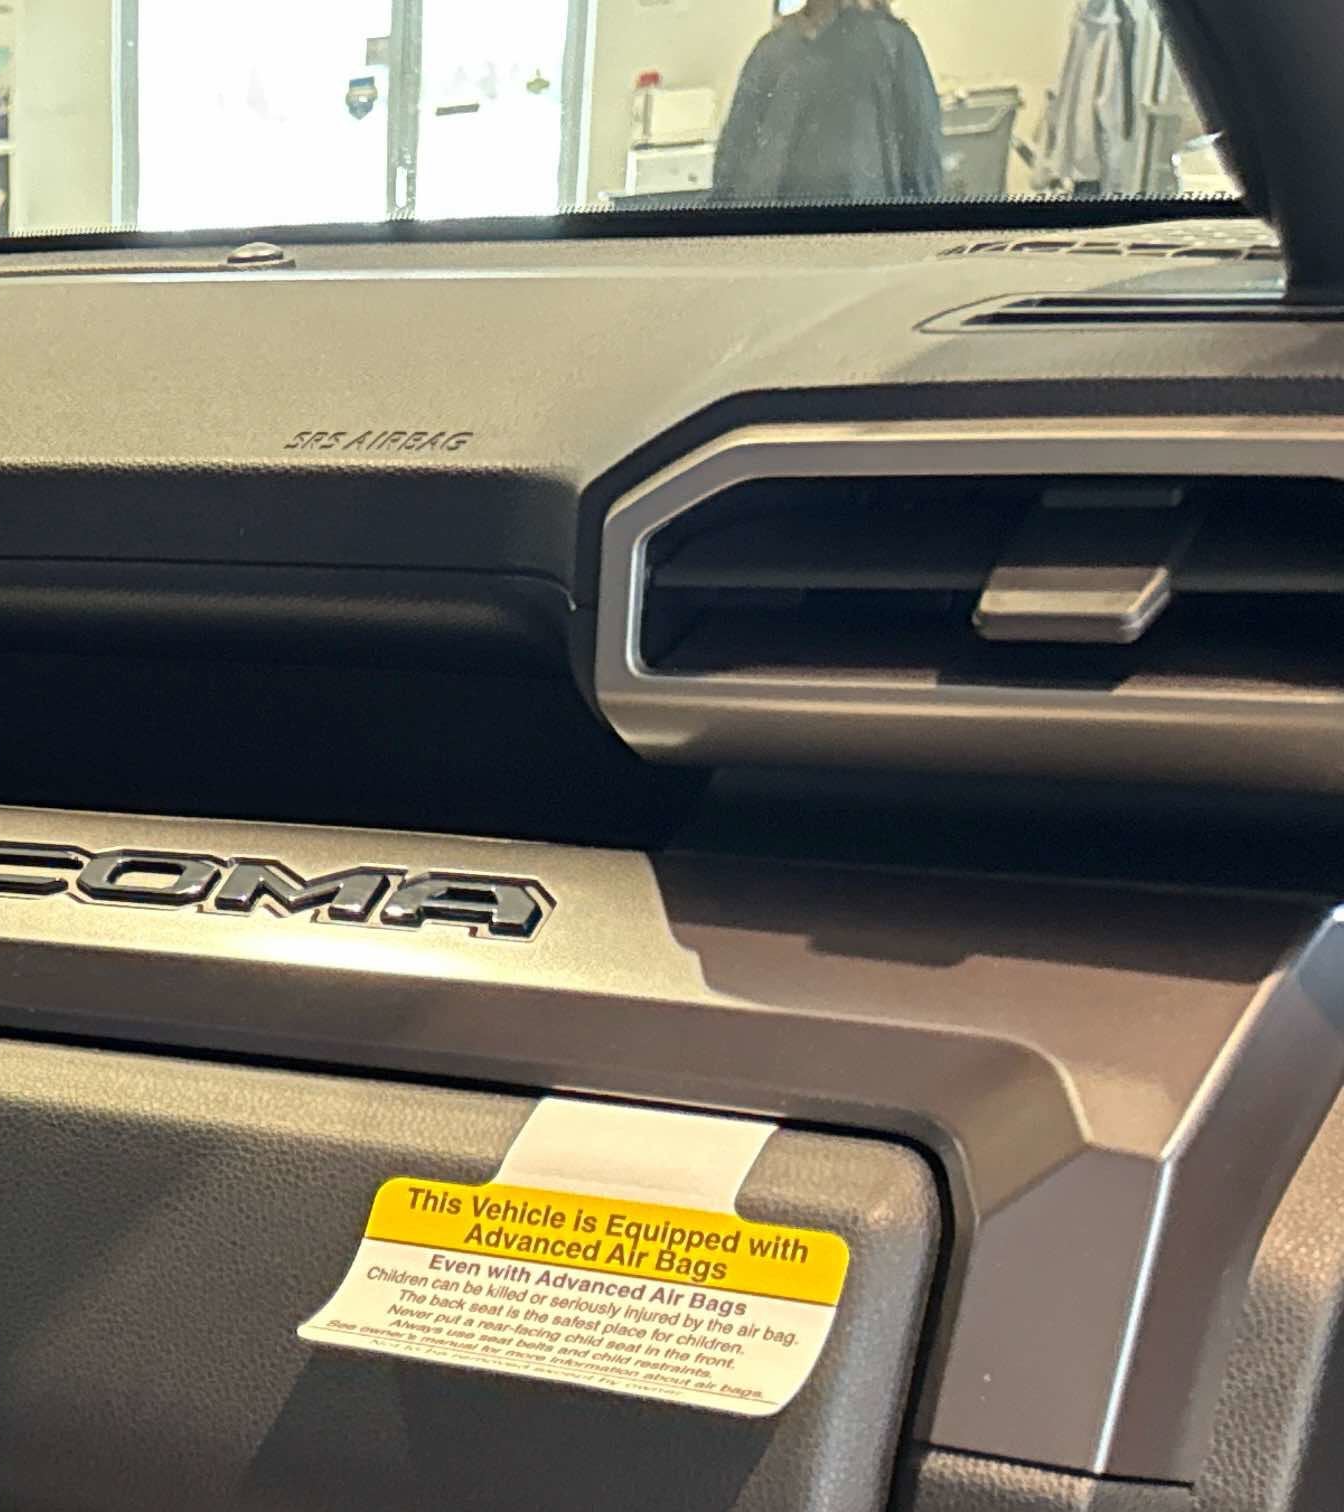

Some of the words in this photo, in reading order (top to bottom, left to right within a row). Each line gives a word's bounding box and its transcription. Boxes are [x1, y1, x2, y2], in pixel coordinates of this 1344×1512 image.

[283, 431, 347, 449] SRS
[343, 430, 474, 451] AIRBAG
[407, 1186, 462, 1215] This
[472, 1194, 566, 1229] Vehicle
[572, 1208, 597, 1233] is
[605, 1213, 741, 1253] Equipped
[749, 1235, 808, 1263] with
[463, 1222, 601, 1261] Advanced
[604, 1242, 649, 1268] Air
[654, 1248, 727, 1283] Bags
[366, 1265, 428, 1287] Children
[431, 1278, 459, 1291] can
[462, 1279, 483, 1295] be
[485, 1283, 527, 1302] killed
[529, 1293, 548, 1304] or
[549, 1296, 622, 1319] seriously
[623, 1304, 681, 1325] injured
[682, 1313, 704, 1332] by
[706, 1318, 733, 1334] the
[736, 1323, 760, 1338] air
[762, 1325, 797, 1347] bag.
[428, 1253, 480, 1276] Even
[487, 1264, 531, 1283] with
[534, 1269, 646, 1300] Advanced
[648, 1286, 684, 1306] Air
[688, 1292, 747, 1317] Bags
[386, 1303, 433, 1319] Never
[432, 1313, 462, 1324] put
[462, 1318, 474, 1326] a
[476, 1320, 561, 1342] rear-facing
[564, 1333, 604, 1347] child
[605, 1340, 642, 1353] seat
[643, 1344, 660, 1356] in
[663, 1347, 690, 1361] the
[693, 1352, 738, 1368] front.
[388, 1318, 443, 1334] Always
[445, 1328, 475, 1339] use
[477, 1334, 513, 1345] seat
[515, 1338, 554, 1352] belts
[556, 1346, 590, 1358] and
[591, 1352, 632, 1364] child
[399, 1288, 427, 1304] The
[428, 1293, 466, 1310] back
[468, 1302, 504, 1316] seat
[505, 1305, 520, 1319] is
[523, 1308, 548, 1323] the
[551, 1315, 601, 1331] safest
[600, 1322, 647, 1339] place
[650, 1327, 673, 1342] for
[675, 1333, 748, 1354] children.
